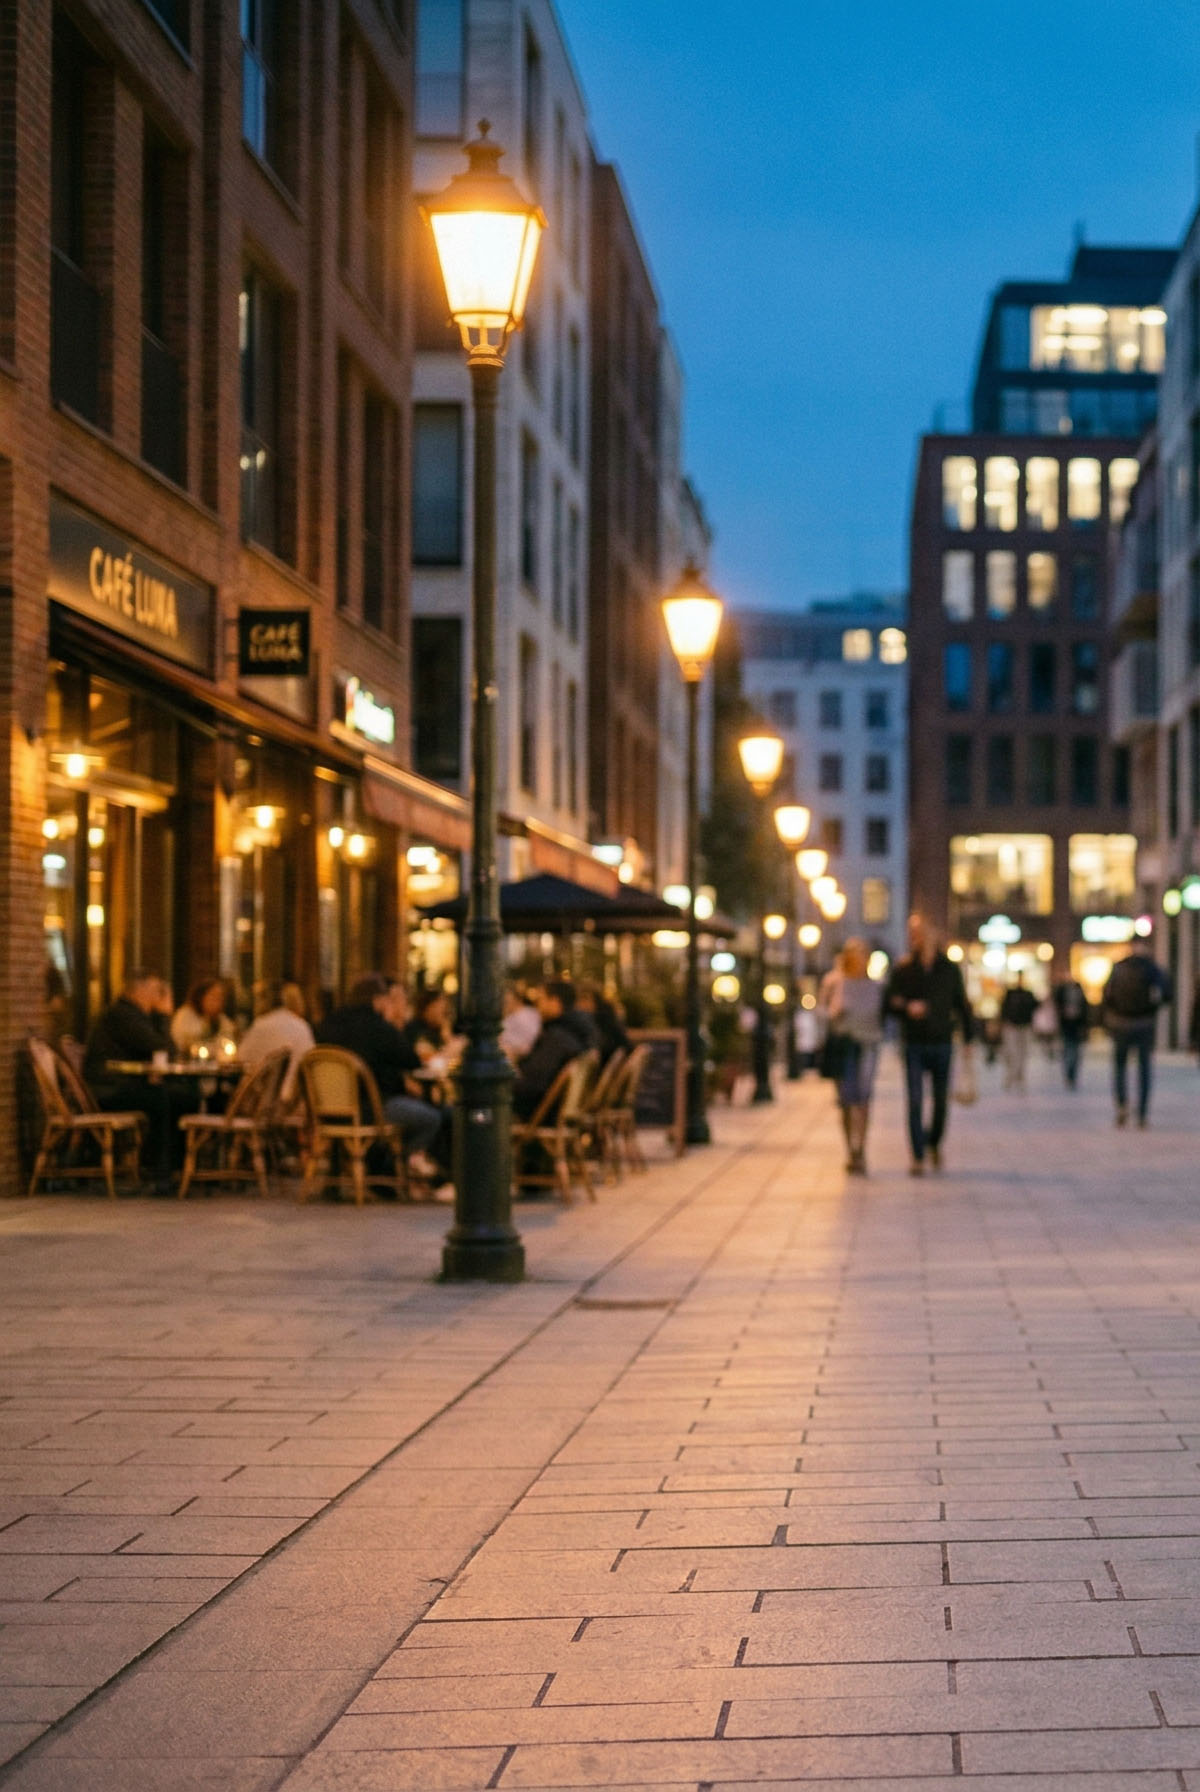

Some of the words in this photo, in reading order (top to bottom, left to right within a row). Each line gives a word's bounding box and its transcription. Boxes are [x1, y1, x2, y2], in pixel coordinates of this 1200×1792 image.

[90, 547, 133, 617] CAFÉ
[136, 570, 178, 637] LUNA
[250, 622, 300, 646] CAFÉ
